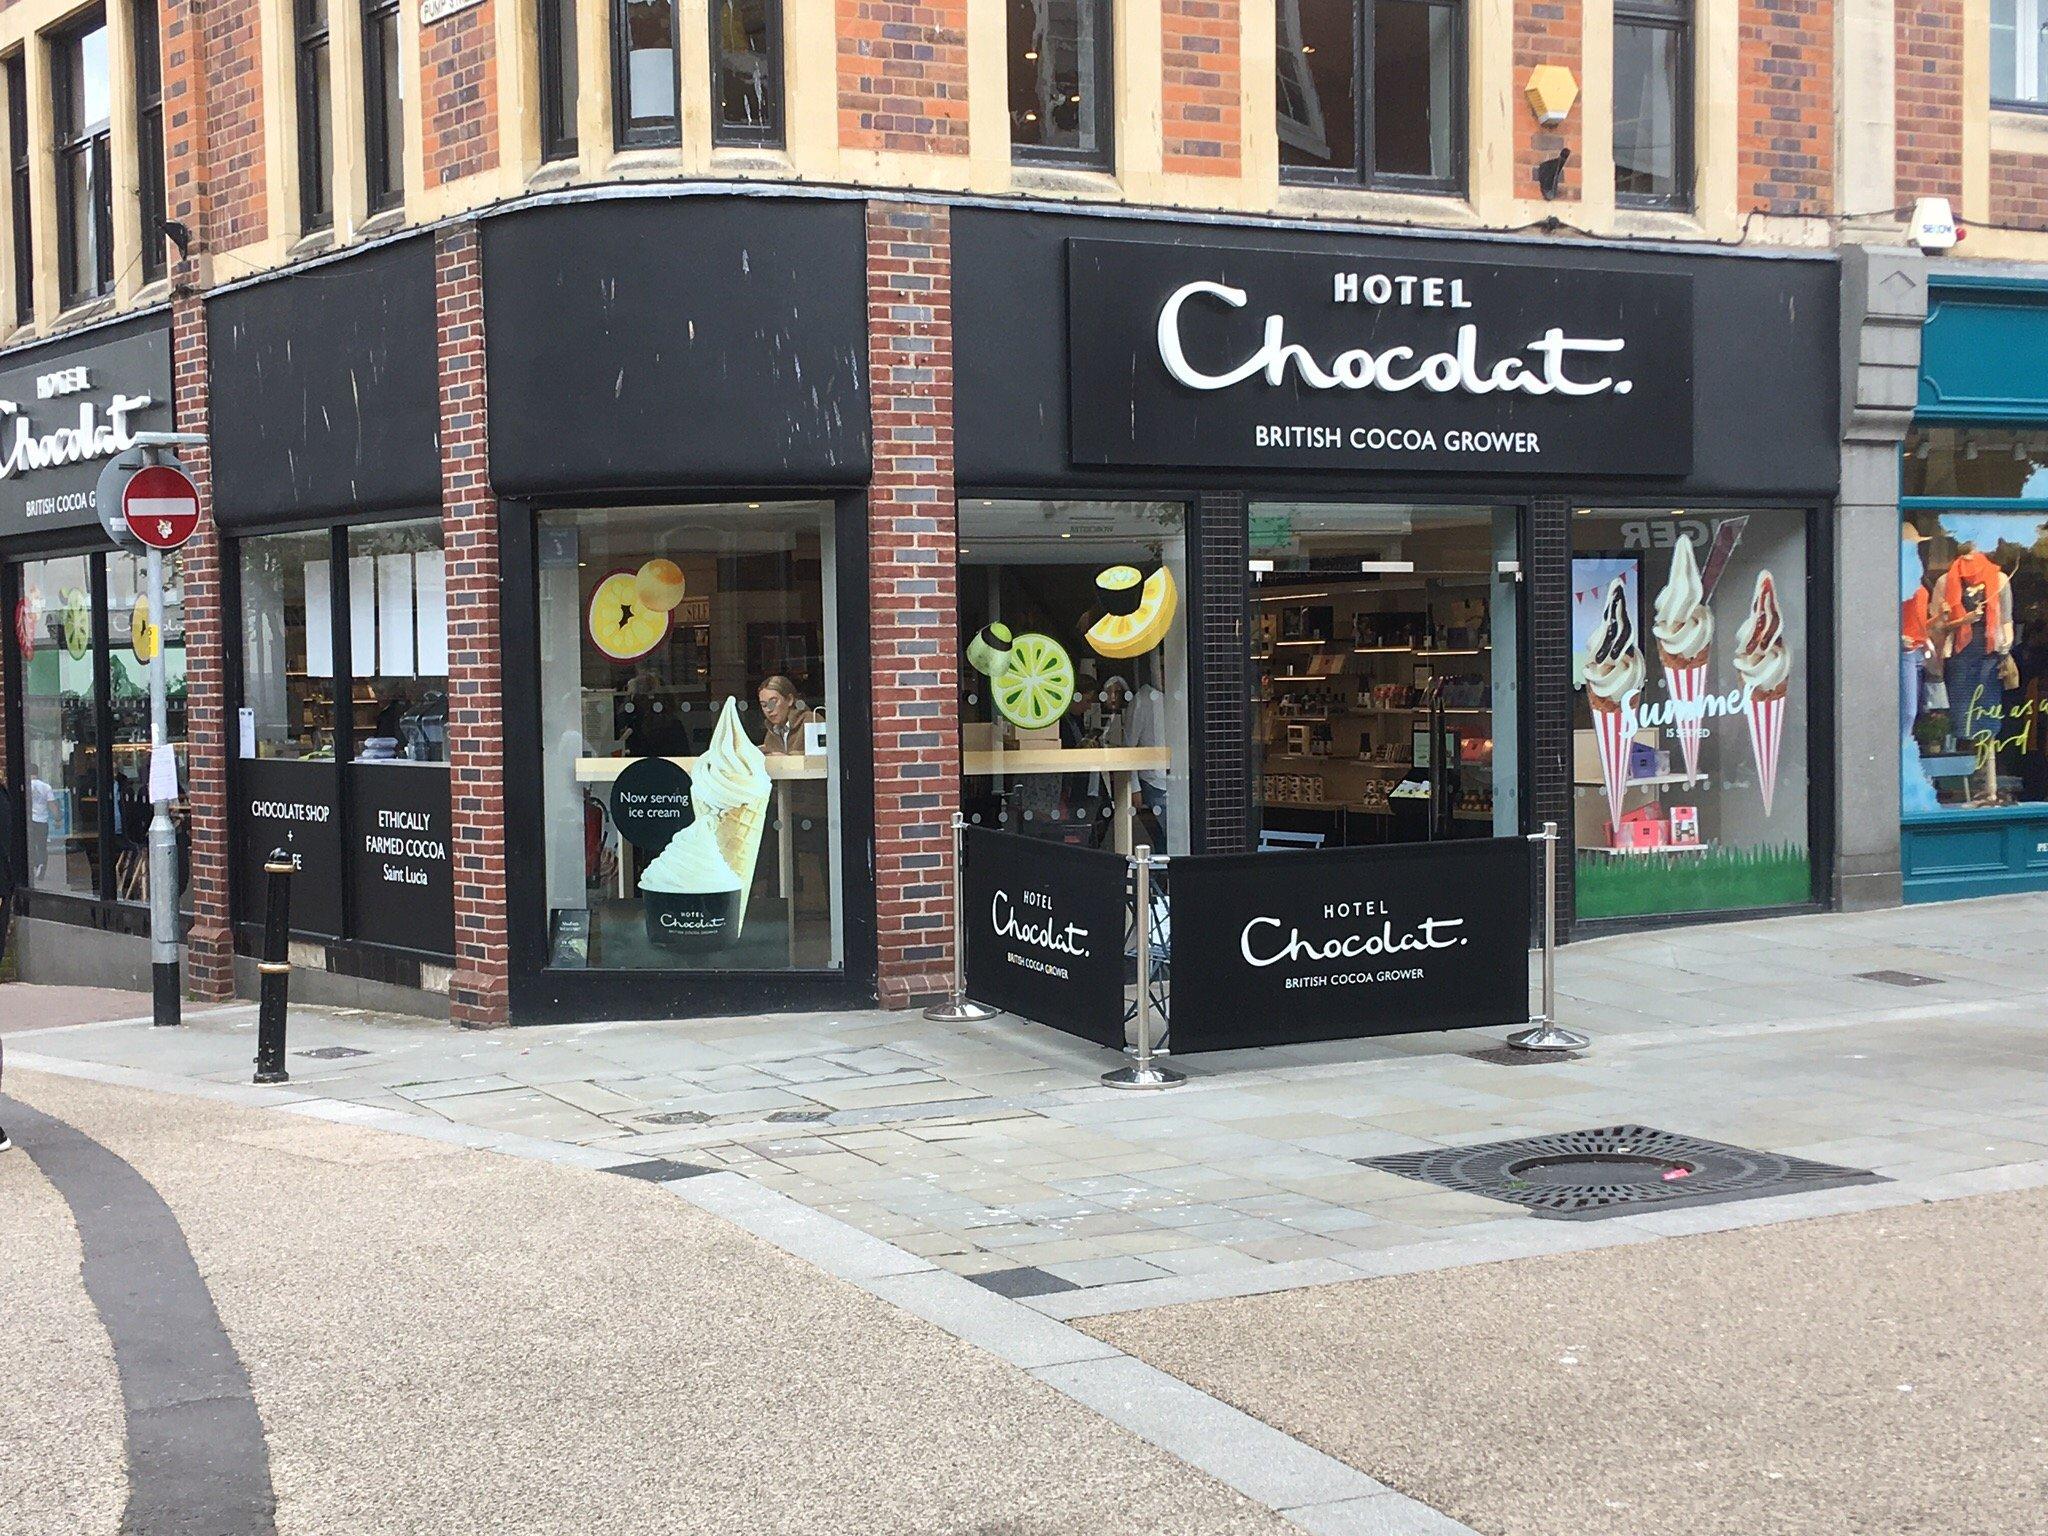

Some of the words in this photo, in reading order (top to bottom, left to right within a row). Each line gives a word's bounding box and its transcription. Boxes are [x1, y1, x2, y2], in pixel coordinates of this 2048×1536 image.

[1334, 272, 1472, 308] HOTEL
[1256, 426, 1342, 449] BRITISH
[1350, 428, 1436, 452] COCOA
[1444, 431, 1541, 453] GROWER
[26, 497, 55, 517] BRITISH
[56, 492, 87, 513] COCOA
[1666, 728, 1675, 738] IS
[620, 792, 648, 804] Now
[650, 792, 689, 807] serving
[252, 800, 304, 821] CHOCOLATE
[305, 804, 330, 822] SHOP
[378, 810, 430, 831] ETHICALLY
[628, 808, 644, 818] ice
[647, 808, 681, 818] cream
[366, 836, 404, 856] FARMED
[405, 839, 446, 860] COCOA
[383, 863, 404, 883] Saint
[405, 865, 428, 885] Lucia
[1023, 890, 1053, 910] HOTEL
[1324, 900, 1388, 919] HOTEL
[1007, 952, 1025, 967] BRITISH
[1285, 975, 1327, 989] BRITISH
[1330, 972, 1374, 986] COCOA
[1376, 968, 1424, 982] GROWER
